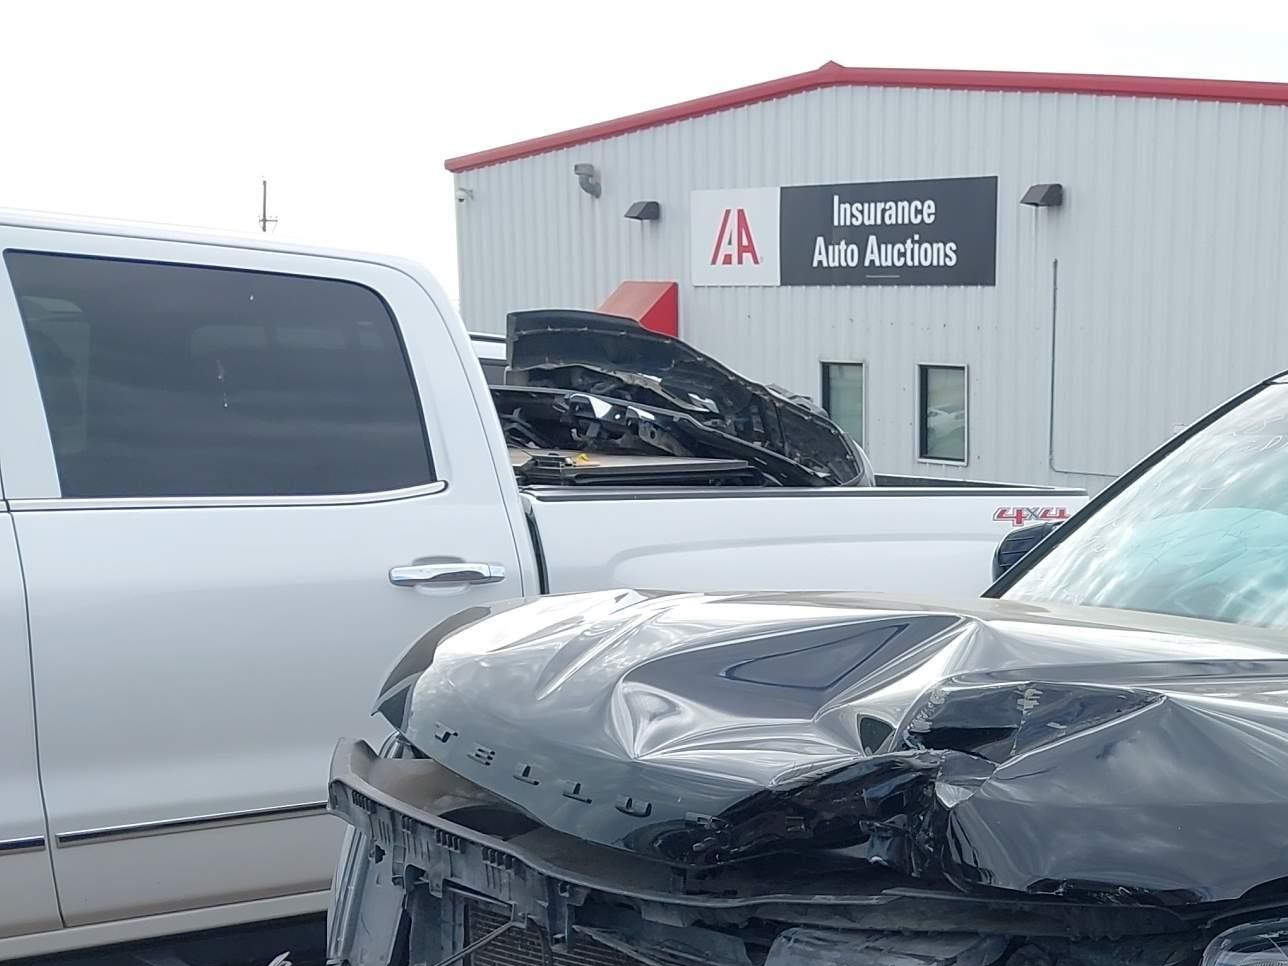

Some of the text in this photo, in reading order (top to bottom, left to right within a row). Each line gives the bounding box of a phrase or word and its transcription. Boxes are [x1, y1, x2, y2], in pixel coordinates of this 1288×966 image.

[832, 194, 936, 227] Insurance
[812, 233, 957, 268] Auto Auctions
